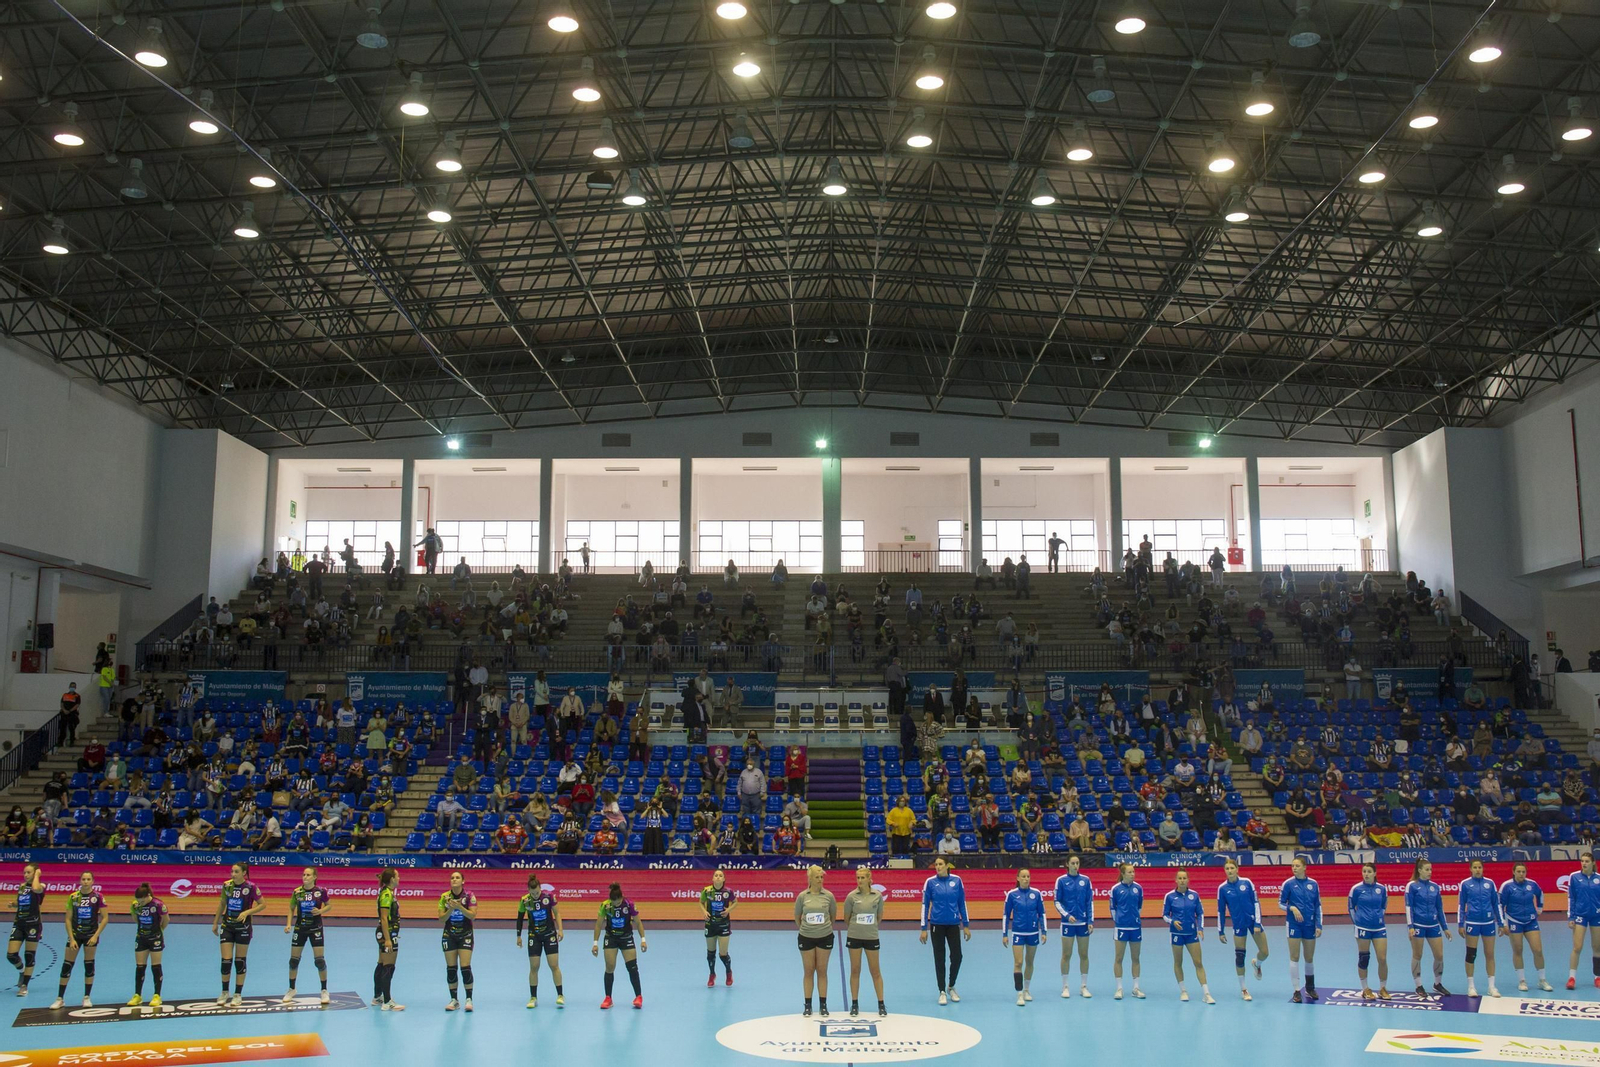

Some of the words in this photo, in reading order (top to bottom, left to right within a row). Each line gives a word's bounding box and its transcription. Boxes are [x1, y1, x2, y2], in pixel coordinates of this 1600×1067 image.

[208, 682, 252, 691] Ayuntamiento
[253, 682, 262, 690] de
[262, 682, 285, 692] Málaga
[367, 683, 411, 693] Ayuntamiento
[412, 684, 421, 692] de
[1271, 683, 1280, 691] de
[1281, 682, 1304, 693] Málaga
[121, 853, 158, 861] CLINICAS
[1389, 850, 1429, 859] CLINICAS
[1457, 849, 1498, 858] CLINICAS
[184, 855, 222, 863] CLINICAS
[249, 855, 286, 863] CLINICAS
[313, 856, 351, 864] CLINICAS
[378, 857, 416, 865] CLINICAS
[232, 890, 240, 898] 19
[305, 893, 313, 901] 18
[714, 894, 722, 902] 10
[80, 899, 89, 907] 22
[535, 902, 540, 910] 9
[141, 909, 149, 917] 20
[1359, 929, 1366, 937] 14
[1323, 1000, 1442, 1011] FERTILIDAD
[58, 1049, 160, 1060] COSTA
[166, 1045, 222, 1054] DEL
[228, 1042, 285, 1050] SOL
